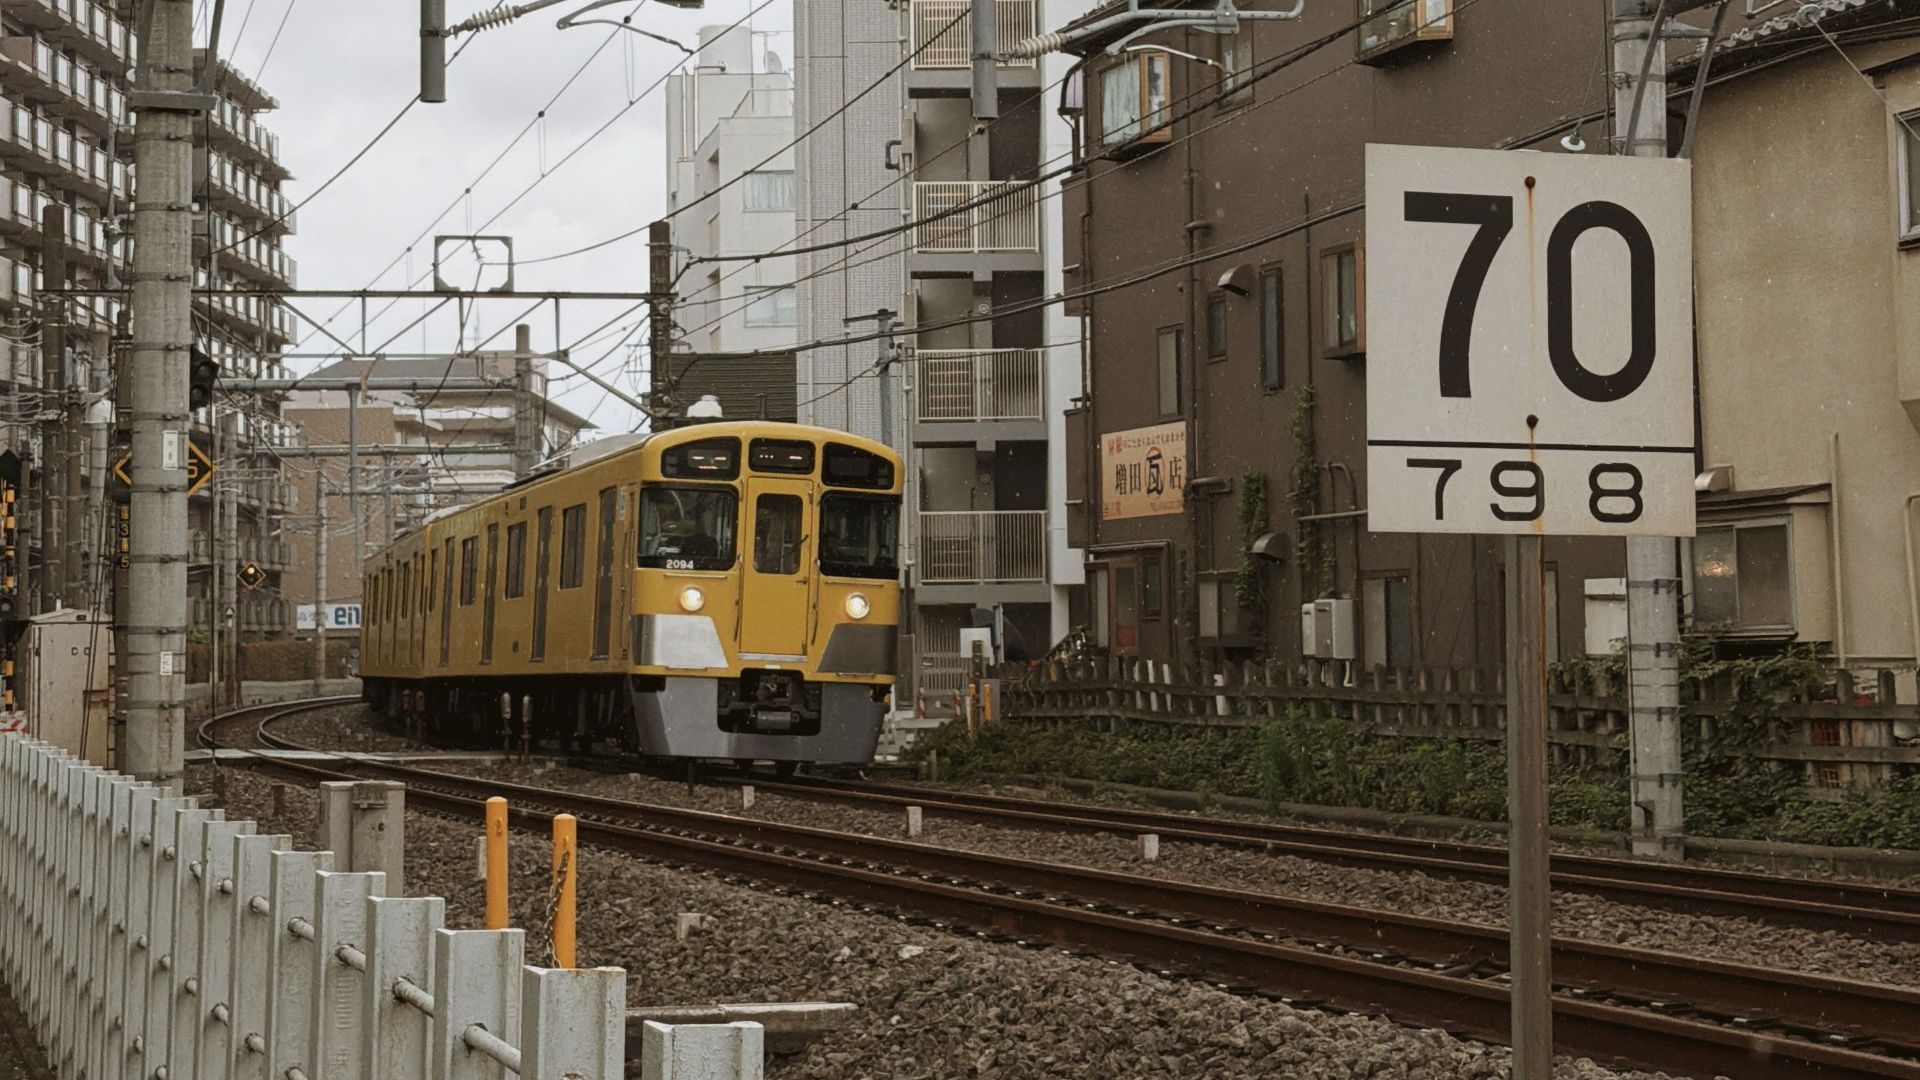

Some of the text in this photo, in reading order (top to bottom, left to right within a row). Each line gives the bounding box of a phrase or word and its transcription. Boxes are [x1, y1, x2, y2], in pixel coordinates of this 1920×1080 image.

[1404, 191, 1656, 403] 70
[1406, 458, 1643, 523] 798
[666, 559, 694, 569] 2094
